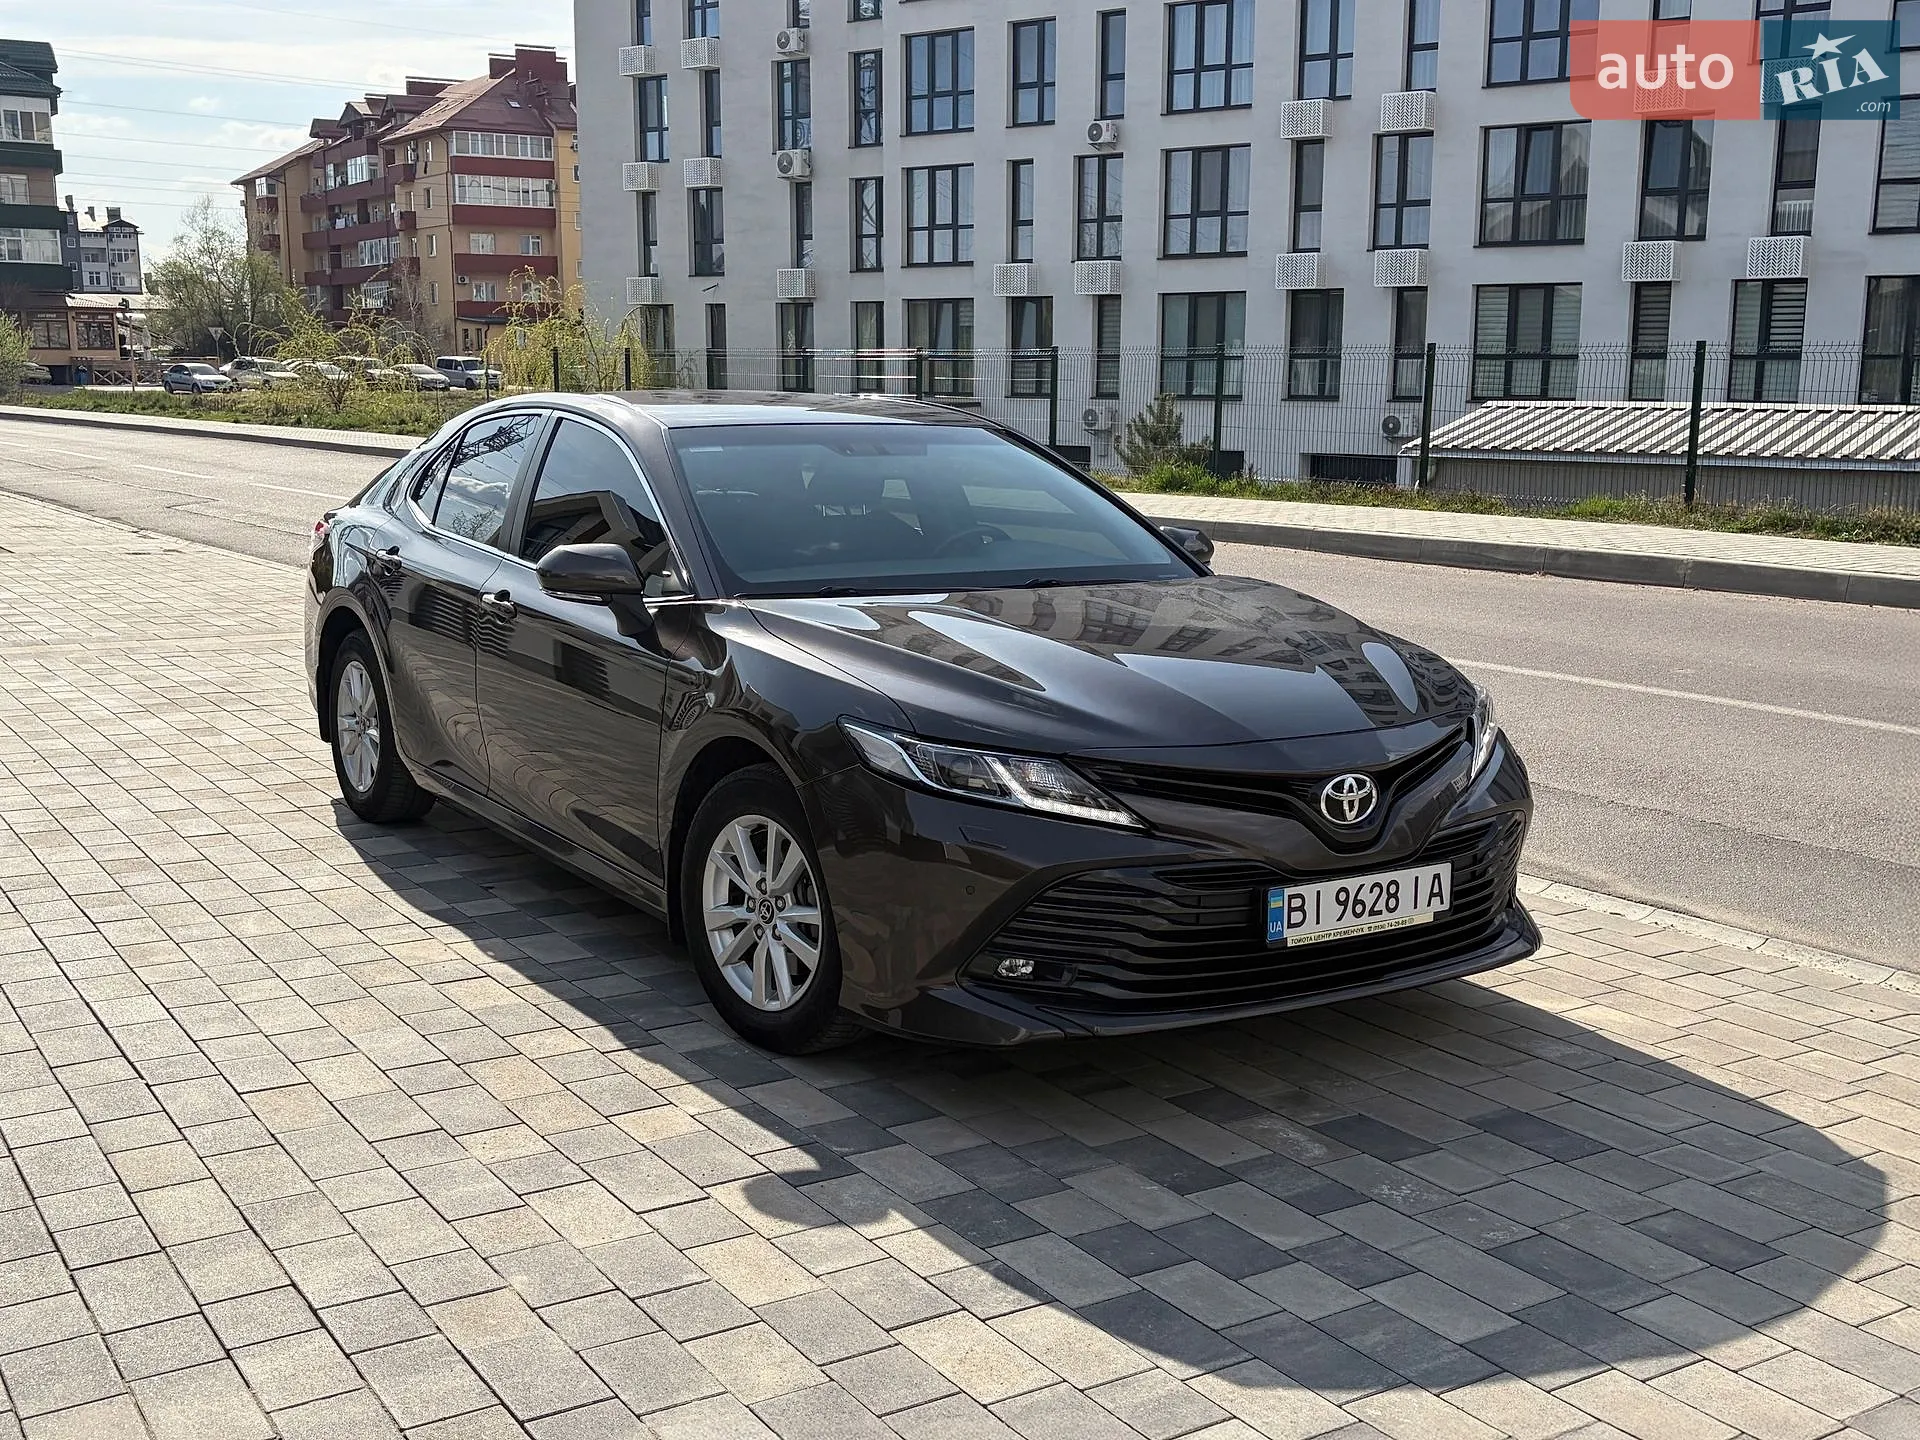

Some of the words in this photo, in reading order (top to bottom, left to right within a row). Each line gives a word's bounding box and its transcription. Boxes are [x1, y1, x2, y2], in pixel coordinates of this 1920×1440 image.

[1287, 890, 1321, 929] BI
[1335, 880, 1400, 922] 9628
[1413, 873, 1444, 909] IA
[1270, 920, 1283, 933] UA
